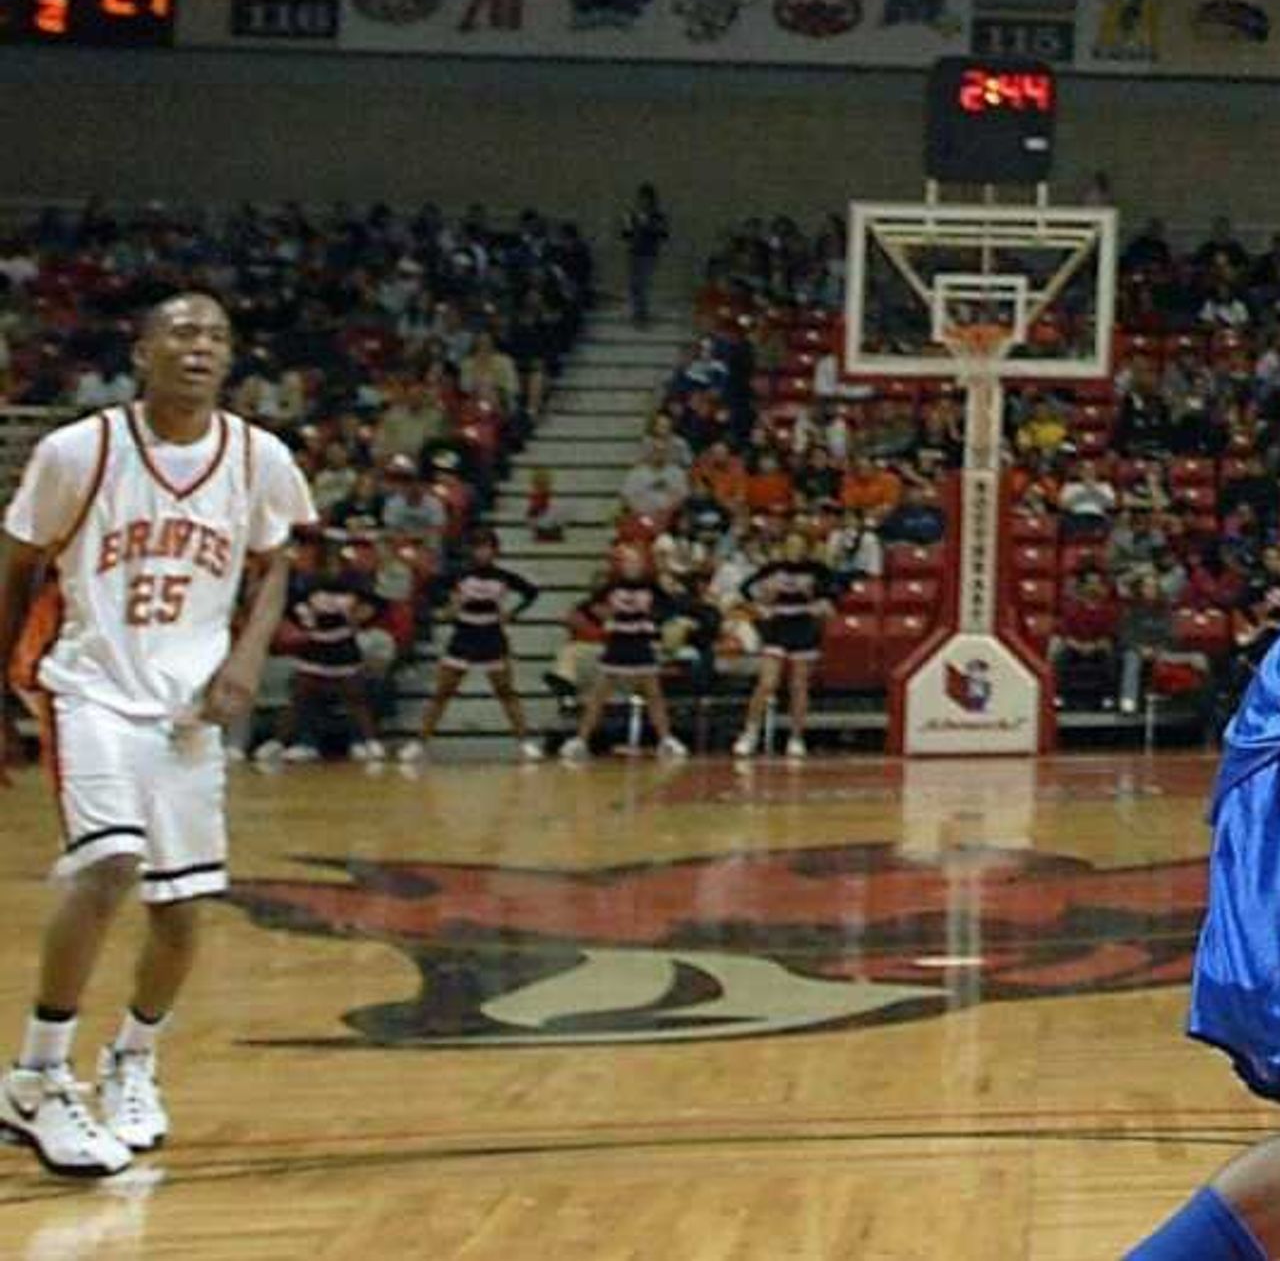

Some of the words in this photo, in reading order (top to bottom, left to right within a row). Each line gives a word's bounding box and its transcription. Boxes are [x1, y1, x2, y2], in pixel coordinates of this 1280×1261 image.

[960, 70, 1051, 111] 2:44
[96, 517, 232, 578] BRAVES
[127, 575, 191, 626] 25
